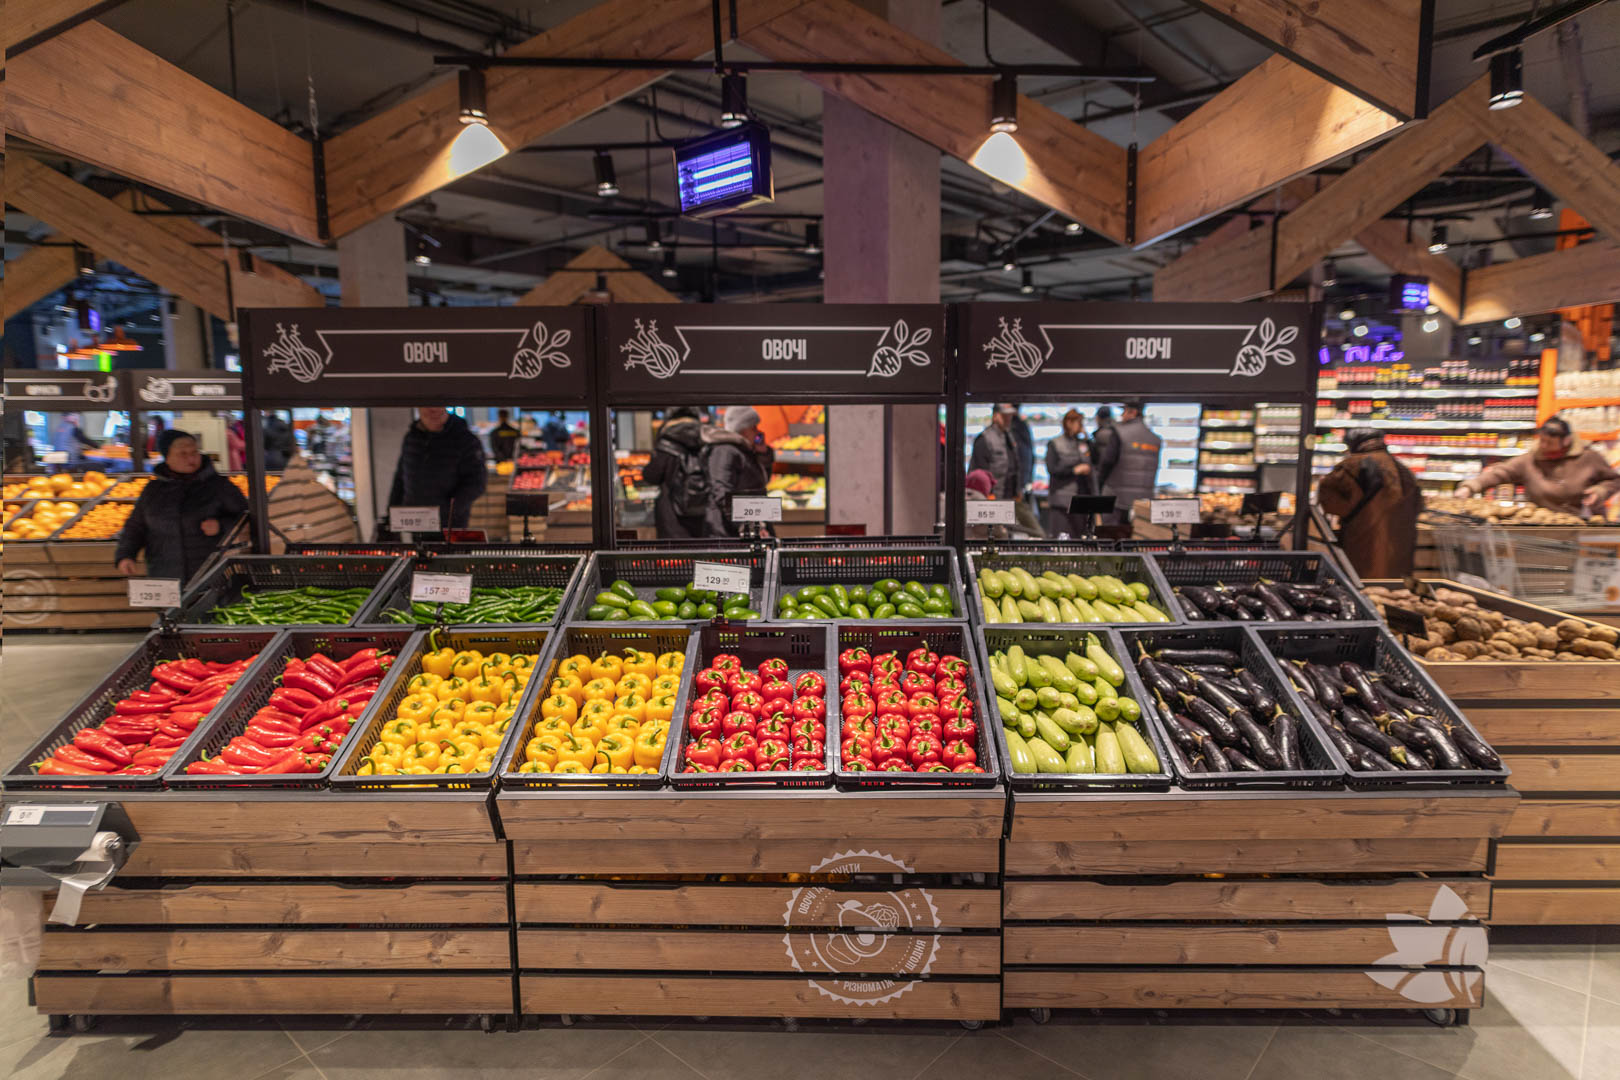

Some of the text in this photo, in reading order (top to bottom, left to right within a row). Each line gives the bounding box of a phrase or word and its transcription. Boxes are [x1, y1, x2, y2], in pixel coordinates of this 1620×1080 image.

[403, 341, 448, 363] ОВОЧІ
[762, 338, 807, 360] ОВОЧІ
[1126, 337, 1171, 359] ОВОЧІ
[705, 576, 721, 584] 129
[798, 890, 817, 915] ОВОЧІ
[904, 939, 927, 971] ЩОДНЯ
